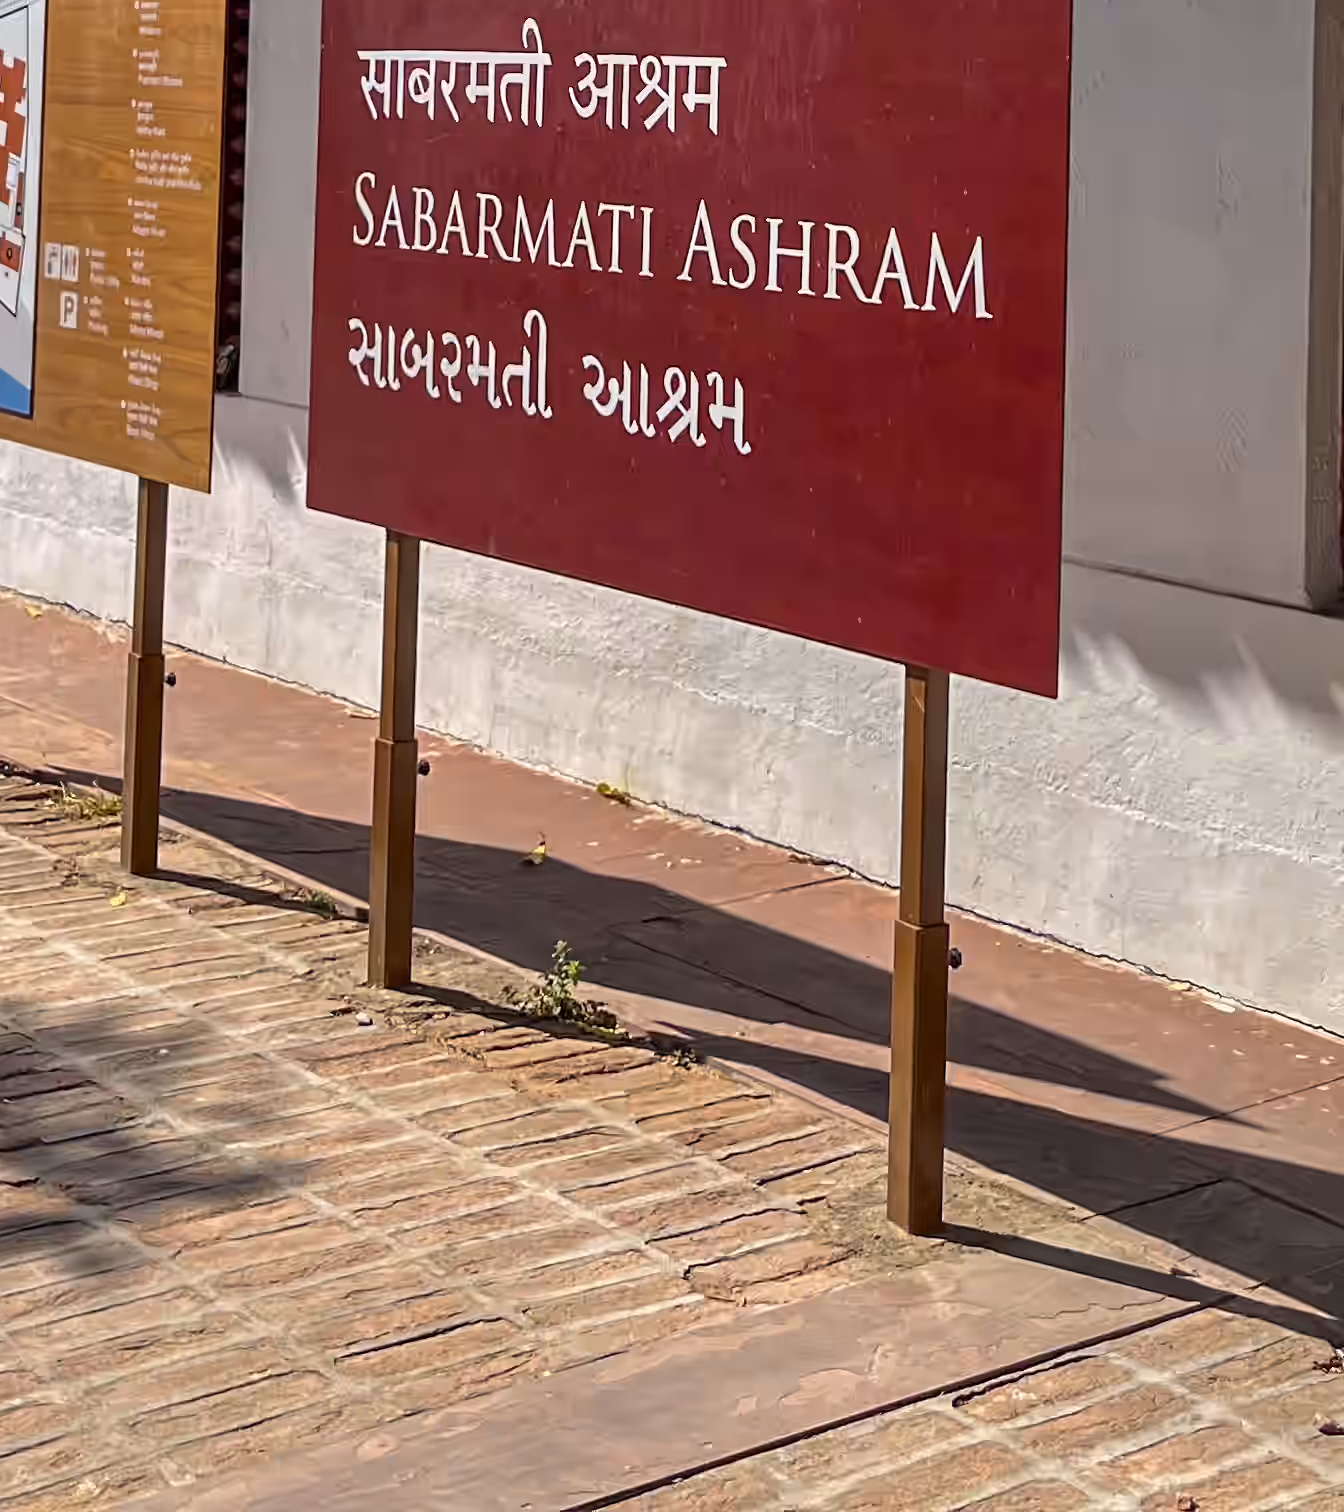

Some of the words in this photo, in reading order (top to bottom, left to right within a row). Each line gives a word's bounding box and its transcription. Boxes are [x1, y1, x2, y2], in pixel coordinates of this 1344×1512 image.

[357, 17, 552, 128] साबरमती
[568, 52, 728, 136] आश्रम
[353, 171, 654, 278] SABARMATI
[676, 198, 994, 319] ASHRAM
[348, 309, 553, 419] સાબરમતી
[581, 354, 752, 455] આશ્રમ
